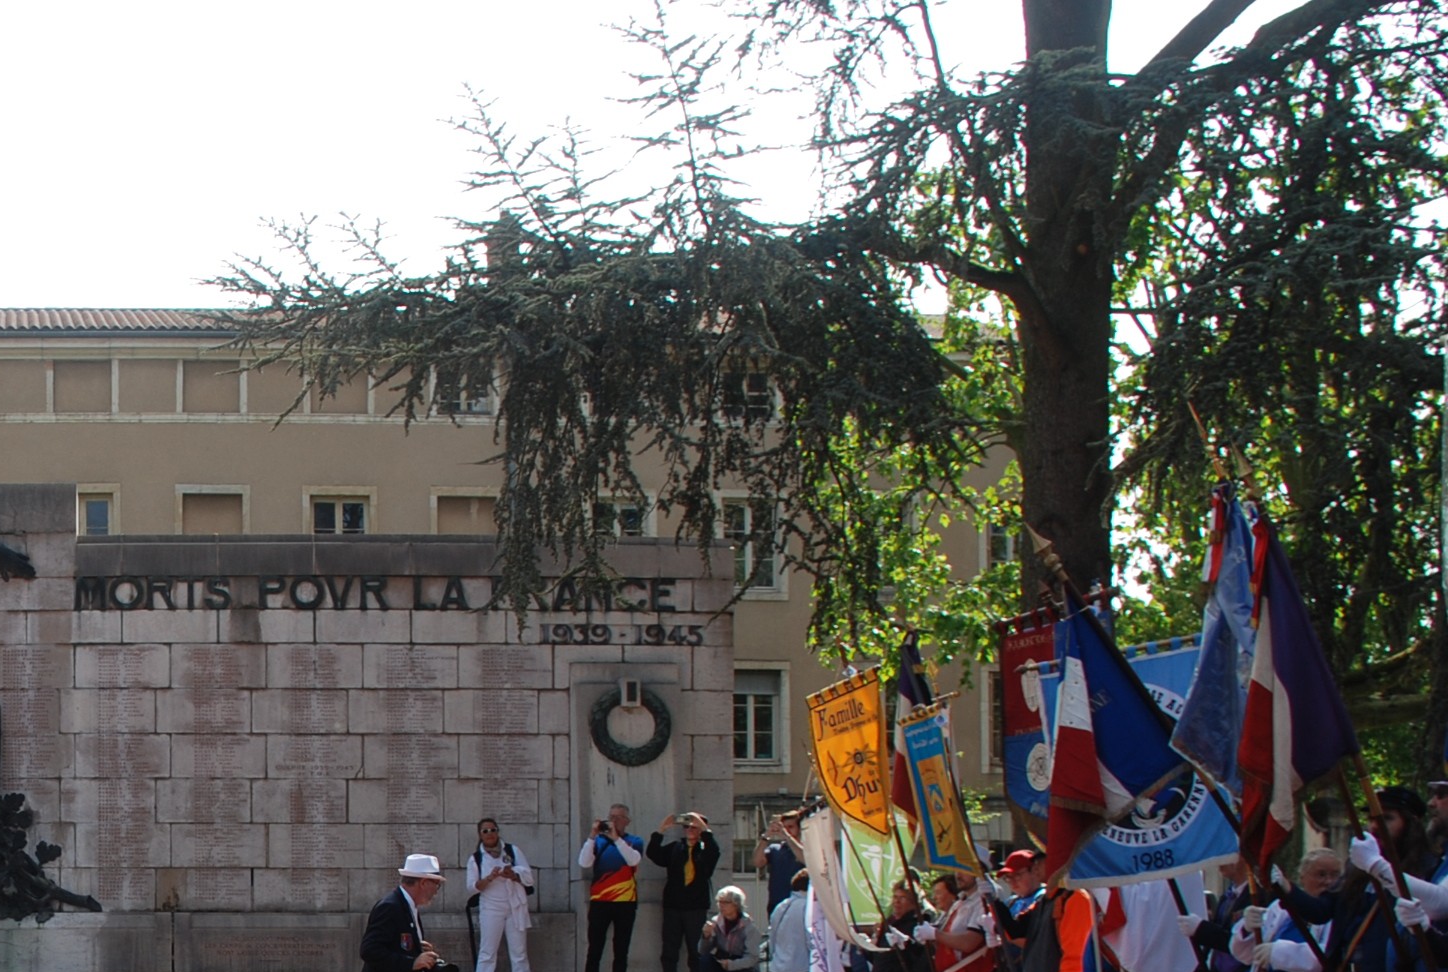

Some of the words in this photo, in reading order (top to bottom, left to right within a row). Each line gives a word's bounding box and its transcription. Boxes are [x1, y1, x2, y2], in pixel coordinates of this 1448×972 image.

[74, 575, 231, 611] MORTS
[258, 575, 388, 611] POVR
[413, 575, 469, 611] LA
[540, 623, 613, 646] 1939
[635, 624, 704, 646] 1945
[814, 698, 865, 742] Famille
[1152, 827, 1169, 842] LA
[1132, 848, 1175, 874] 1988
